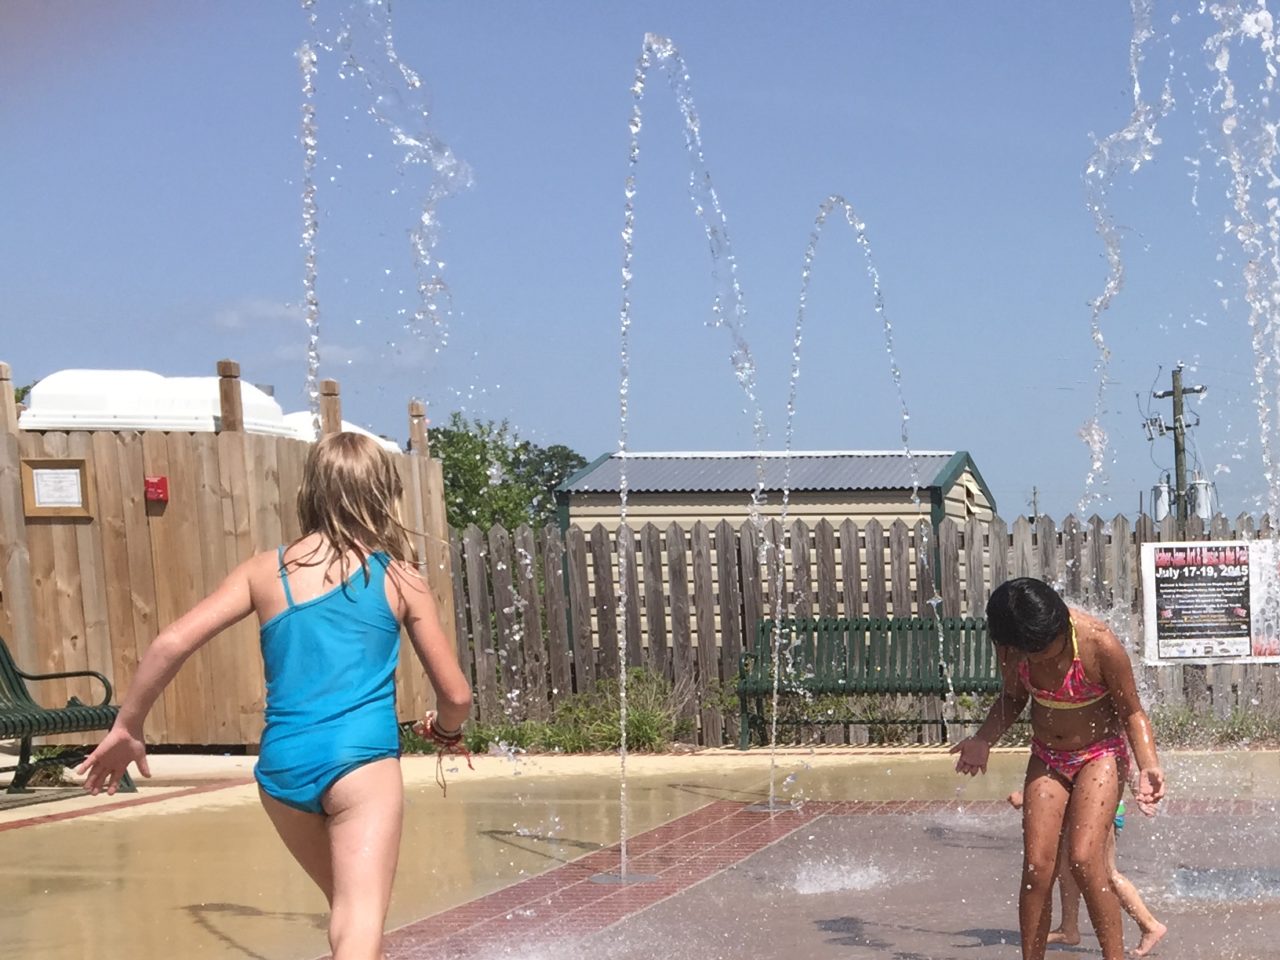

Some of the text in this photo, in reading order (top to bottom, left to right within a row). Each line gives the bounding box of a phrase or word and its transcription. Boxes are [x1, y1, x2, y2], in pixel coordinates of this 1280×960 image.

[1155, 565, 1248, 579] July 17-19, 2015
